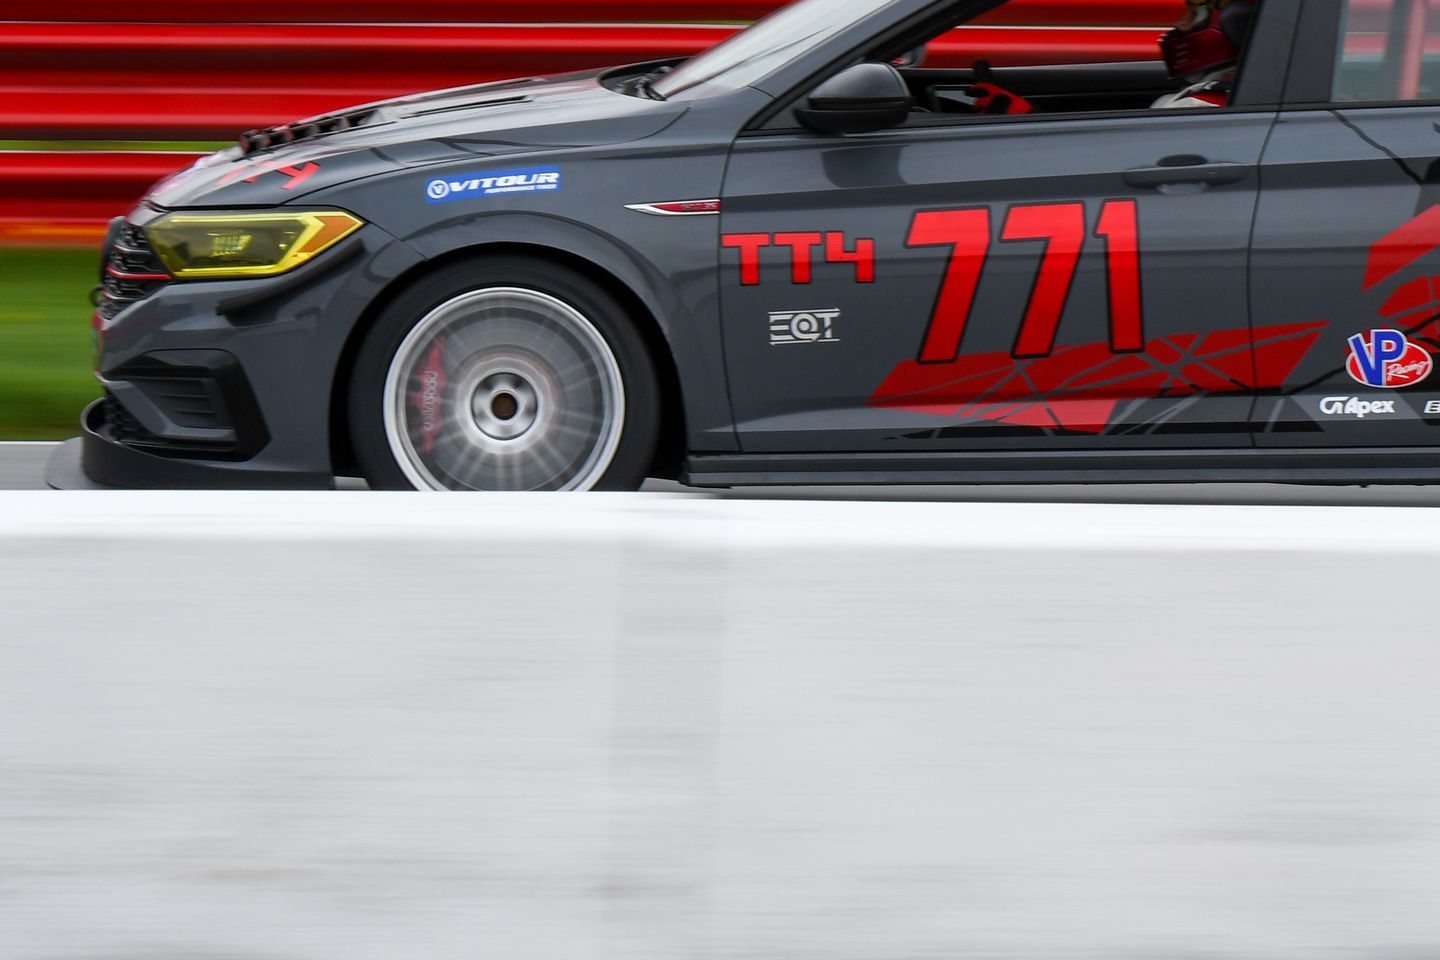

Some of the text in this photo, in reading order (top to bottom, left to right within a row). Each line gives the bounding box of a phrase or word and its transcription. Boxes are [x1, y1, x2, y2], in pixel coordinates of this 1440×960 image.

[448, 172, 560, 192] VITOUR
[721, 230, 876, 286] TT4
[904, 197, 1146, 365] 771
[768, 309, 840, 343] EQT
[1347, 329, 1407, 386] VP
